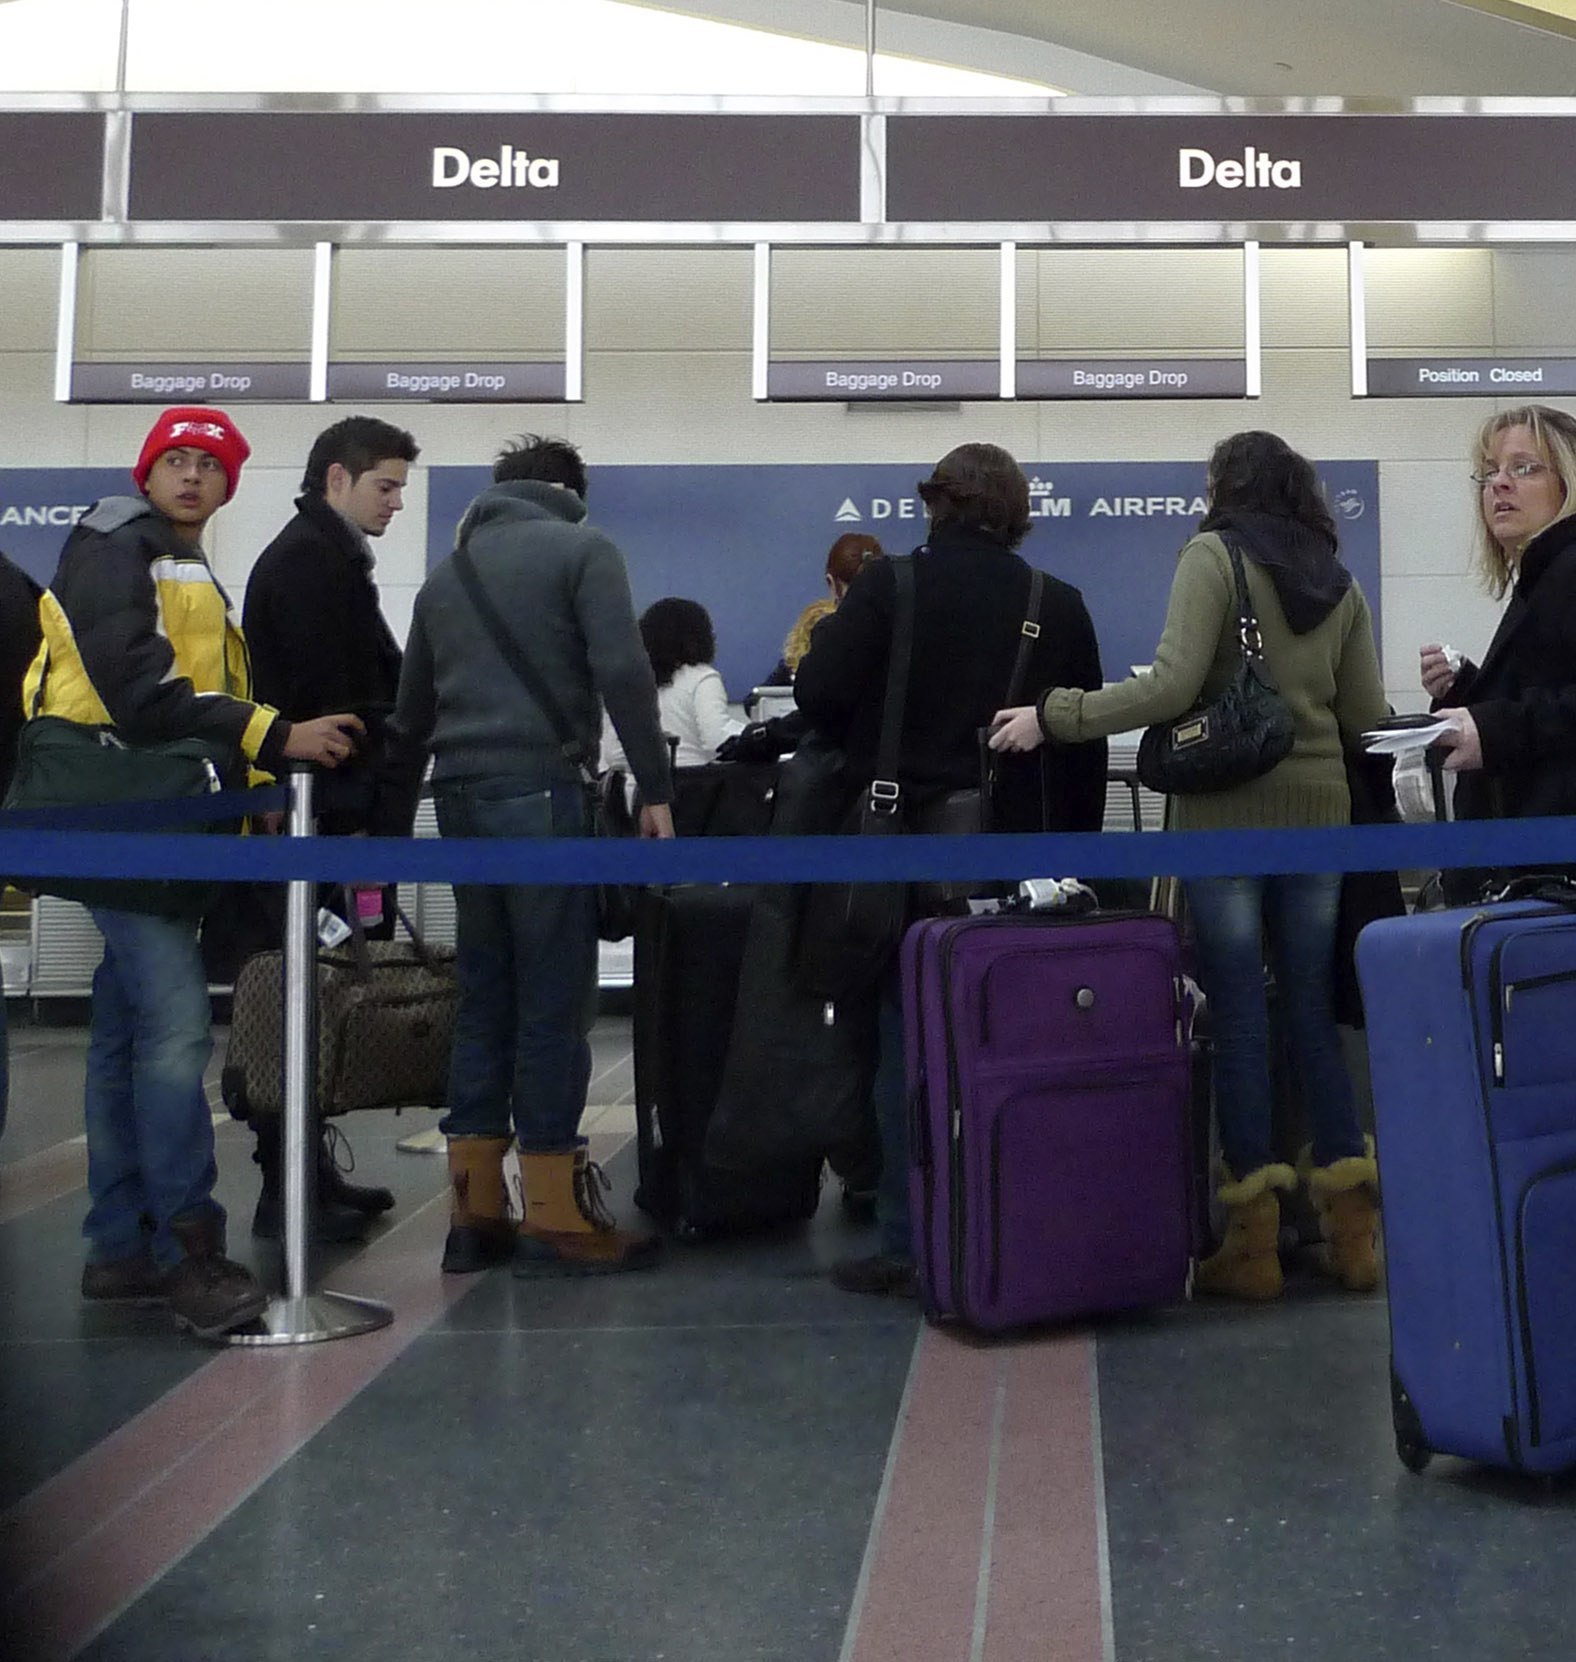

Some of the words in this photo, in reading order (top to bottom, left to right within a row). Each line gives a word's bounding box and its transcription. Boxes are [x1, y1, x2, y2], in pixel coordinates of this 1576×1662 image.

[432, 145, 559, 188] Delta
[1179, 146, 1301, 188] Delta
[130, 373, 206, 391] Baggage
[210, 373, 251, 391] Drop
[386, 373, 461, 391] Baggage
[465, 373, 505, 390] Drop
[825, 371, 898, 390] Baggage
[902, 372, 941, 390] Drop
[1073, 370, 1145, 389] Baggage
[1149, 370, 1188, 389] Drop
[1419, 367, 1479, 382] Position
[1489, 367, 1542, 382] Closed
[1029, 498, 1072, 517] LM
[1088, 497, 1210, 517] AIRFRA
